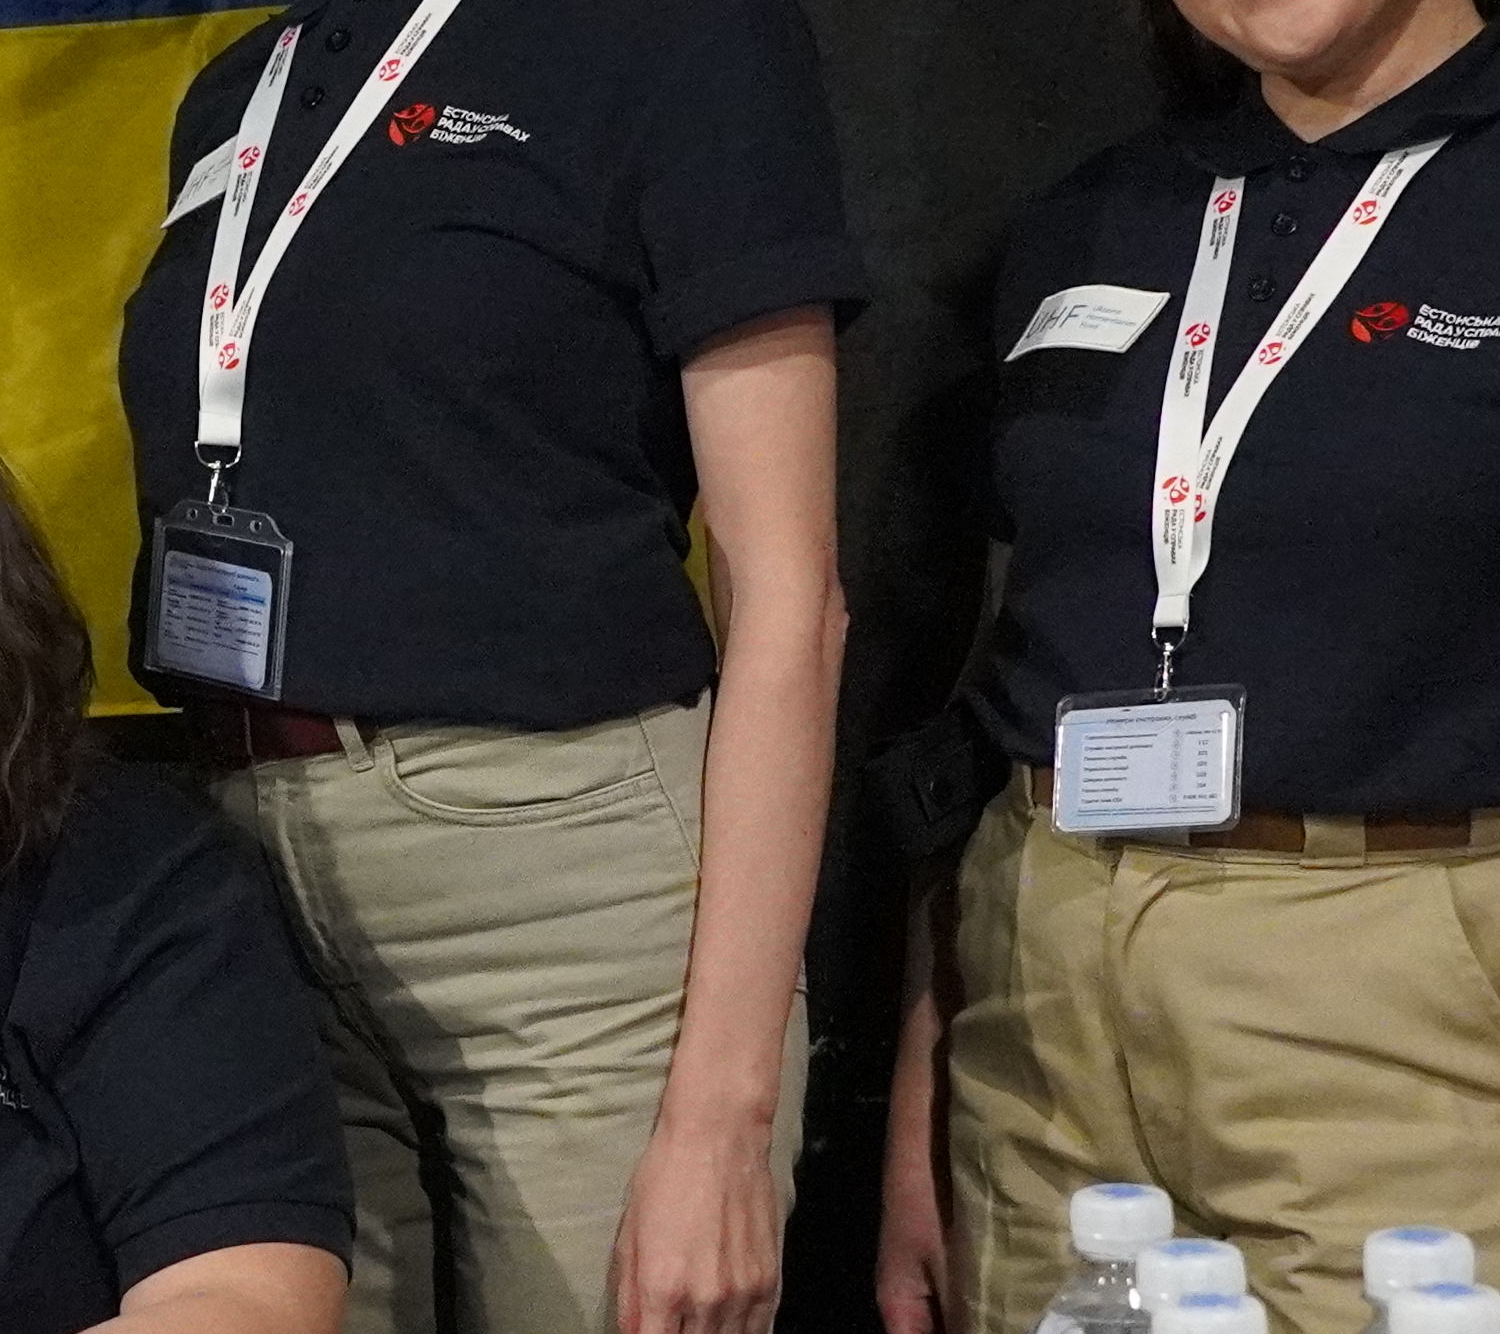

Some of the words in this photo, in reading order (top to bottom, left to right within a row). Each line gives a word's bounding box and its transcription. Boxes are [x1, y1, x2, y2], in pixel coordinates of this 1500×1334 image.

[437, 117, 470, 134] РАДА
[1026, 304, 1087, 339] UHF
[1414, 316, 1455, 337] РАДА
